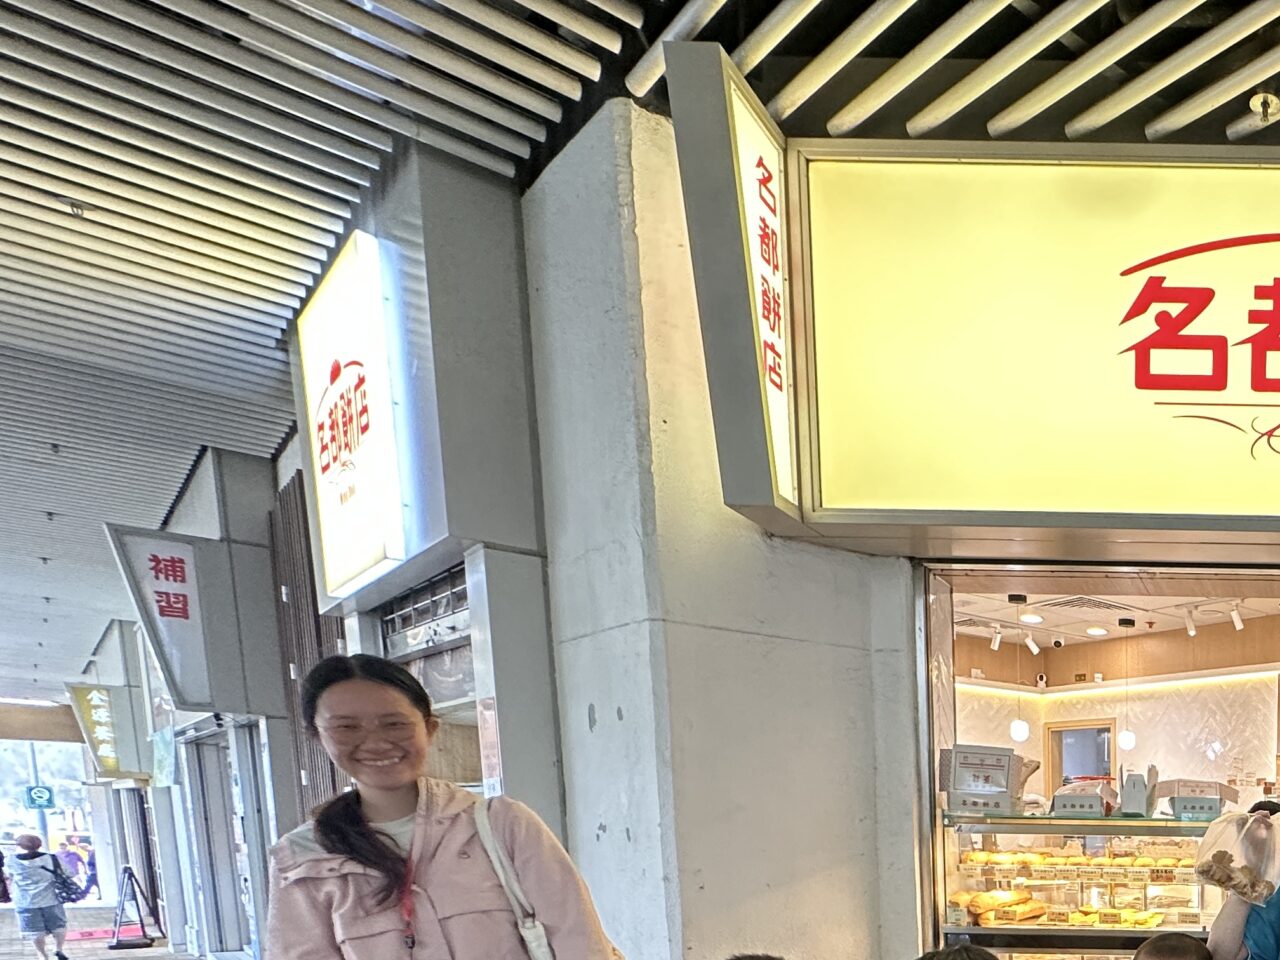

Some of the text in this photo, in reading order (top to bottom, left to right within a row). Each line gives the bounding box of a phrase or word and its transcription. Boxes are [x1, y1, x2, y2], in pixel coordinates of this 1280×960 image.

[755, 155, 783, 392] 名都餅店
[148, 553, 190, 620] 補習
